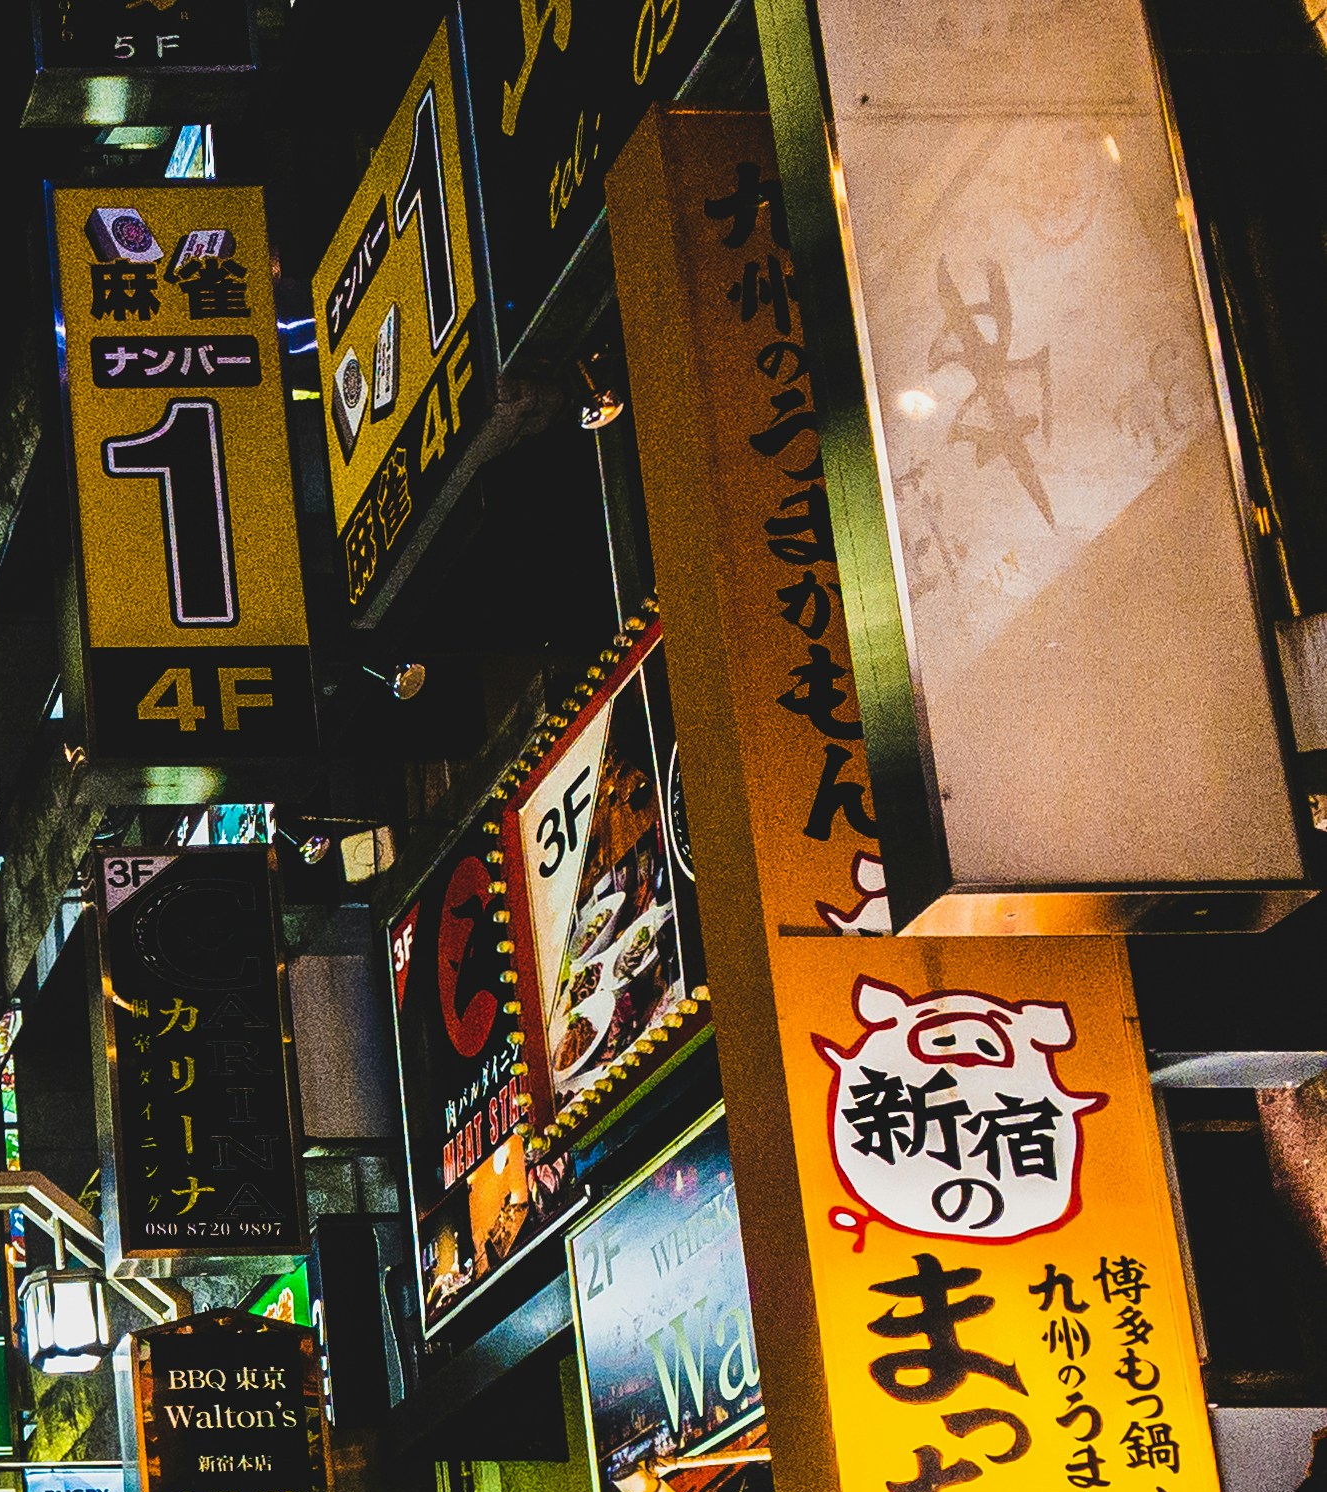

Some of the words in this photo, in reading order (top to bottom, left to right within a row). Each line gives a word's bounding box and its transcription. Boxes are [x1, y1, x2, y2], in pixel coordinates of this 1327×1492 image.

[90, 260, 251, 322] 麻雀
[103, 346, 253, 377] ナンバー
[419, 336, 474, 475] 4F
[104, 397, 239, 629] 1
[136, 665, 275, 733] 4F
[534, 764, 594, 881] 3F
[107, 858, 154, 889] 3F
[392, 922, 414, 972] 3F
[156, 996, 216, 1217] カリーナ
[841, 1065, 1064, 1182] 新宿
[442, 1110, 483, 1191] MEAT
[145, 1220, 182, 1237] 080
[186, 1220, 231, 1237] 8720
[930, 1178, 1004, 1232] の
[167, 1369, 227, 1391] BBQ
[235, 1367, 287, 1391] 東京
[1091, 1255, 1181, 1475] 博多もつ鍋
[163, 1400, 298, 1430] Walton's
[197, 1454, 273, 1473] 新宿本店
